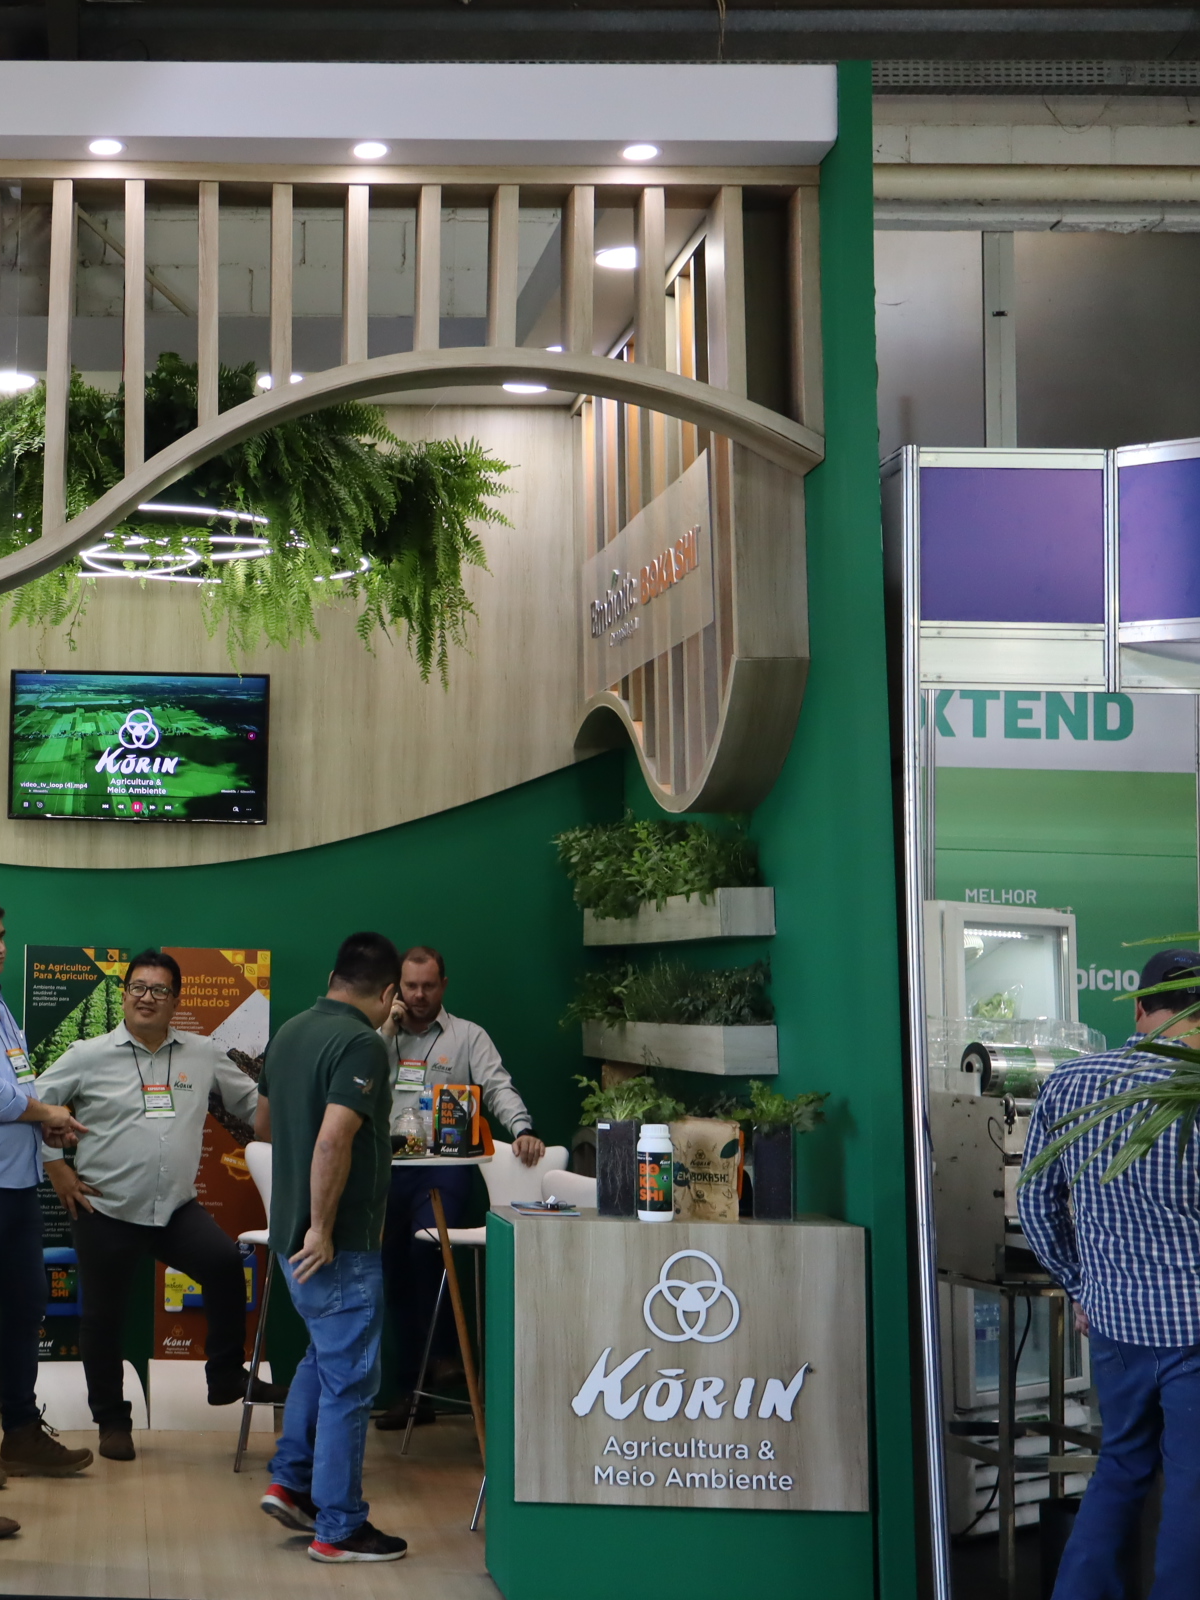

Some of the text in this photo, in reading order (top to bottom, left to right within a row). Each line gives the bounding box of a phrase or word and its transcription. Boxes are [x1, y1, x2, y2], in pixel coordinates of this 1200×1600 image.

[20, 781, 64, 789] video_tv_loop
[110, 778, 162, 786] Agricultura &
[128, 787, 167, 795] Ambiente
[965, 888, 1037, 904] MELHOR
[33, 962, 91, 972] De Agricultor
[33, 971, 98, 981] Para Agricultor
[181, 974, 235, 985] ansforme
[180, 985, 240, 996] síduos em
[180, 997, 230, 1007] sultados
[441, 1117, 456, 1125] SHI
[51, 1288, 69, 1297] SHI
[602, 1436, 775, 1460] Agricultura &
[594, 1465, 793, 1491] Meio Ambiente
